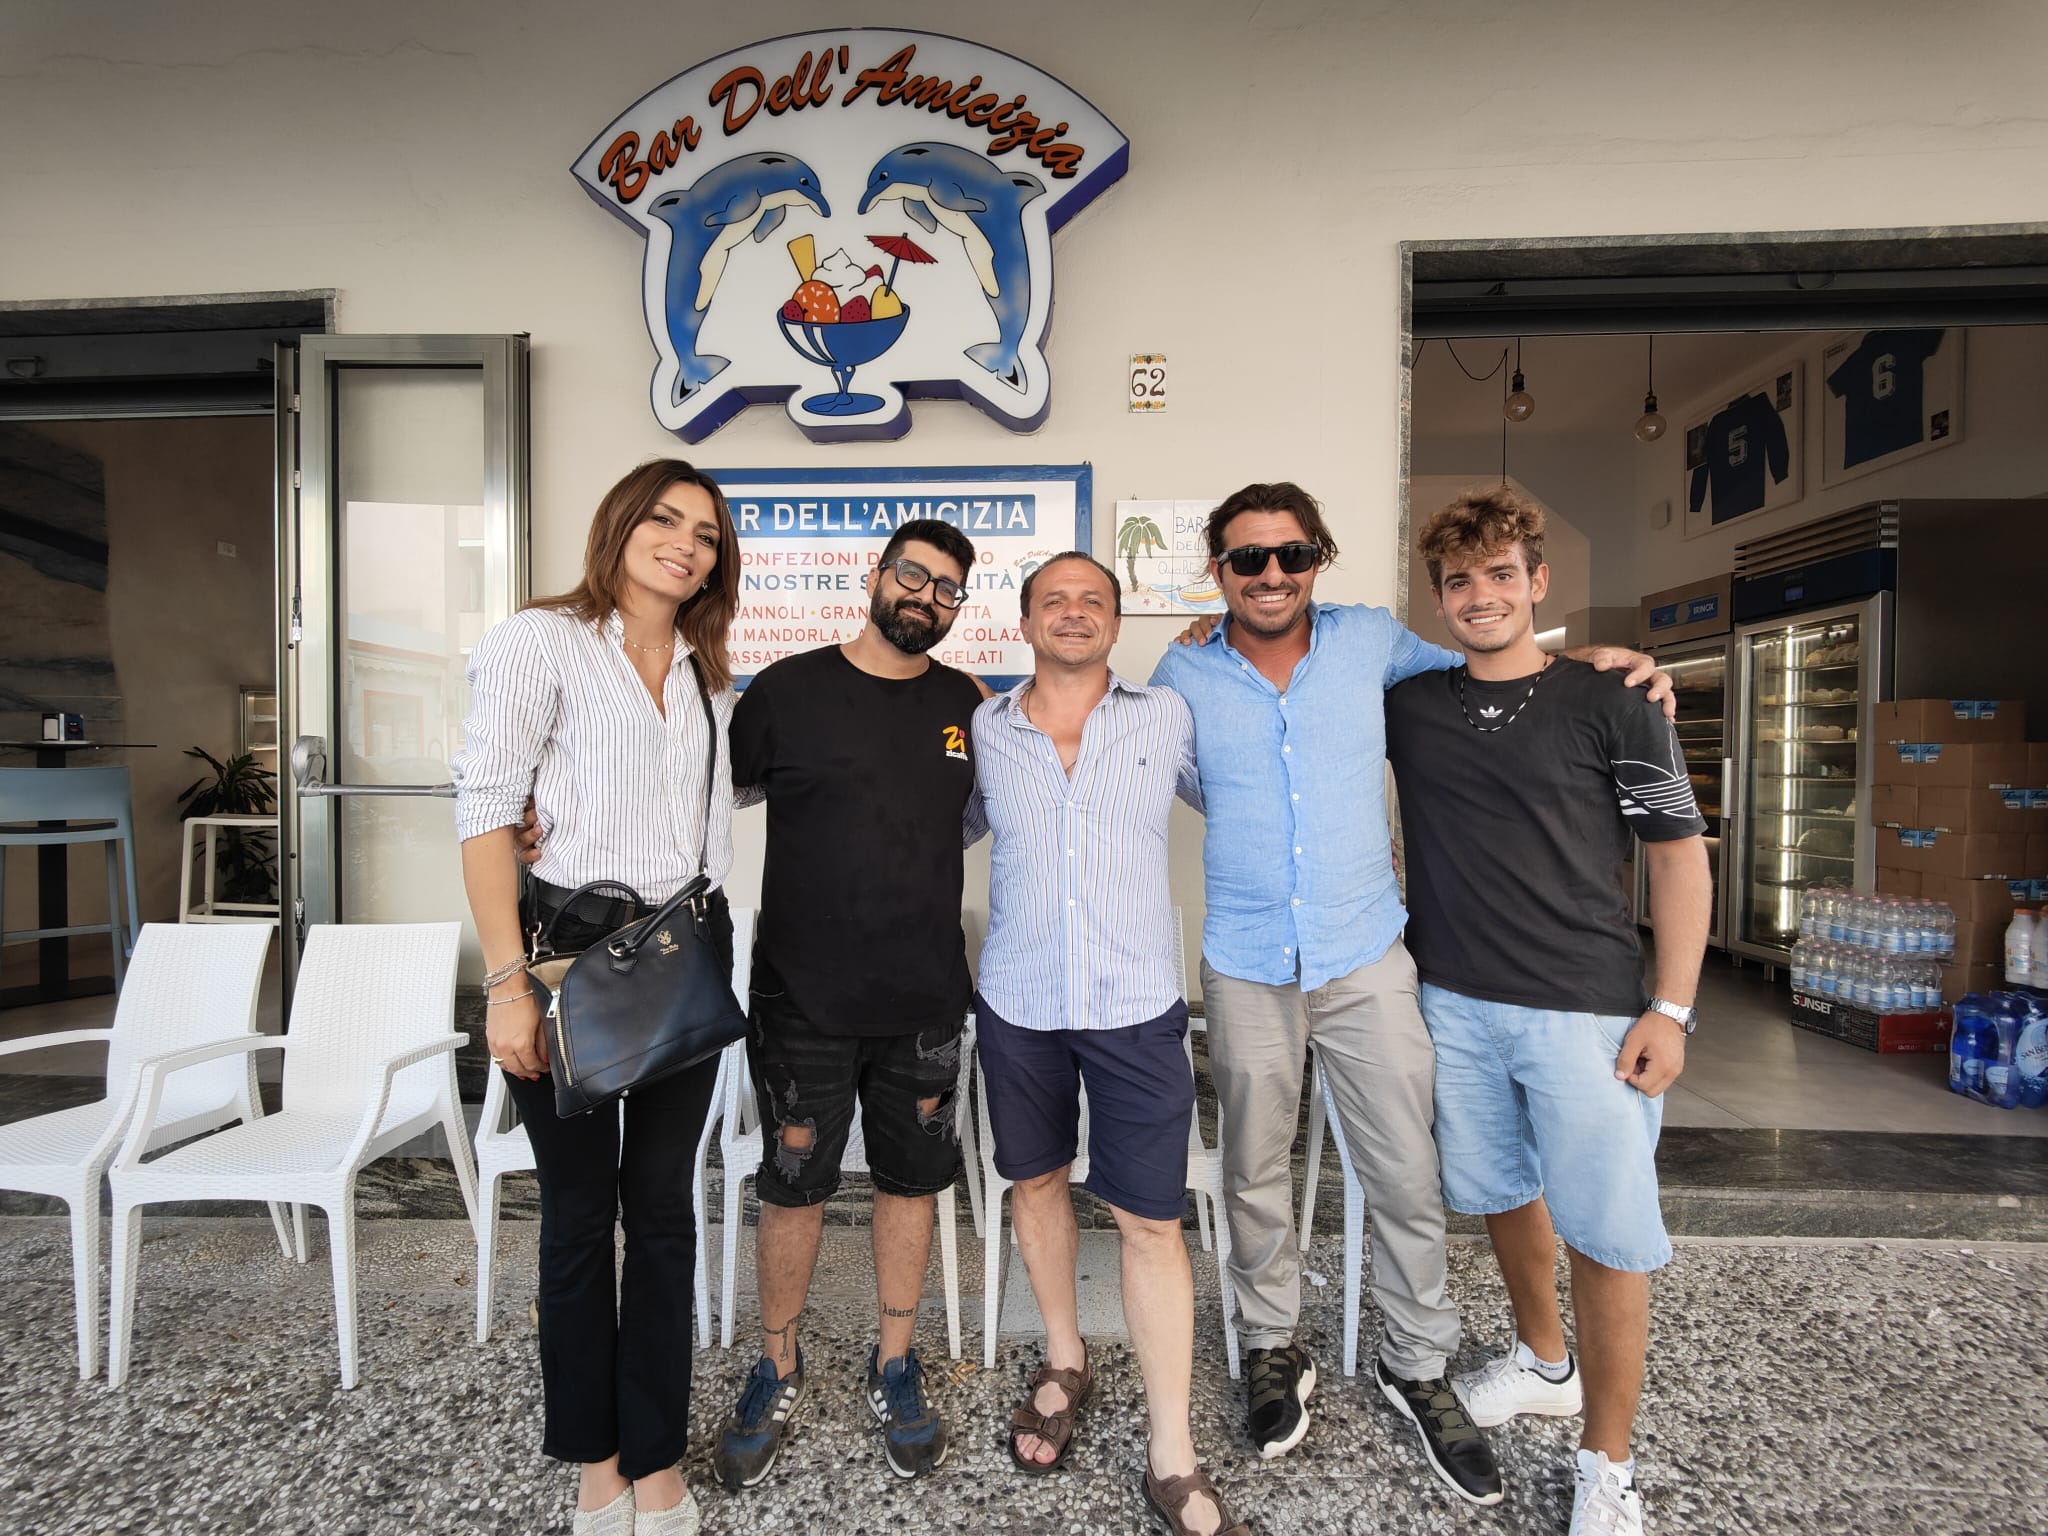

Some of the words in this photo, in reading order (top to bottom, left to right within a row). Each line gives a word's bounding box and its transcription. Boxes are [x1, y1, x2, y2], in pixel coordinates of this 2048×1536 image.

[599, 115, 702, 203] Bar
[1131, 368, 1166, 397] 62
[1872, 353, 1896, 400] 6
[1728, 424, 1748, 467] 5
[1175, 516, 1204, 534] BAR
[740, 552, 858, 566] ONFEZIONI
[745, 574, 850, 591] NOSTRE
[736, 606, 805, 620] ANNOLI
[820, 606, 868, 620] GRAN
[743, 629, 841, 642] MANDORLA
[963, 628, 1021, 642] COLAZ
[941, 650, 1003, 664] GELATI
[1792, 994, 1833, 1015] SUNSET
